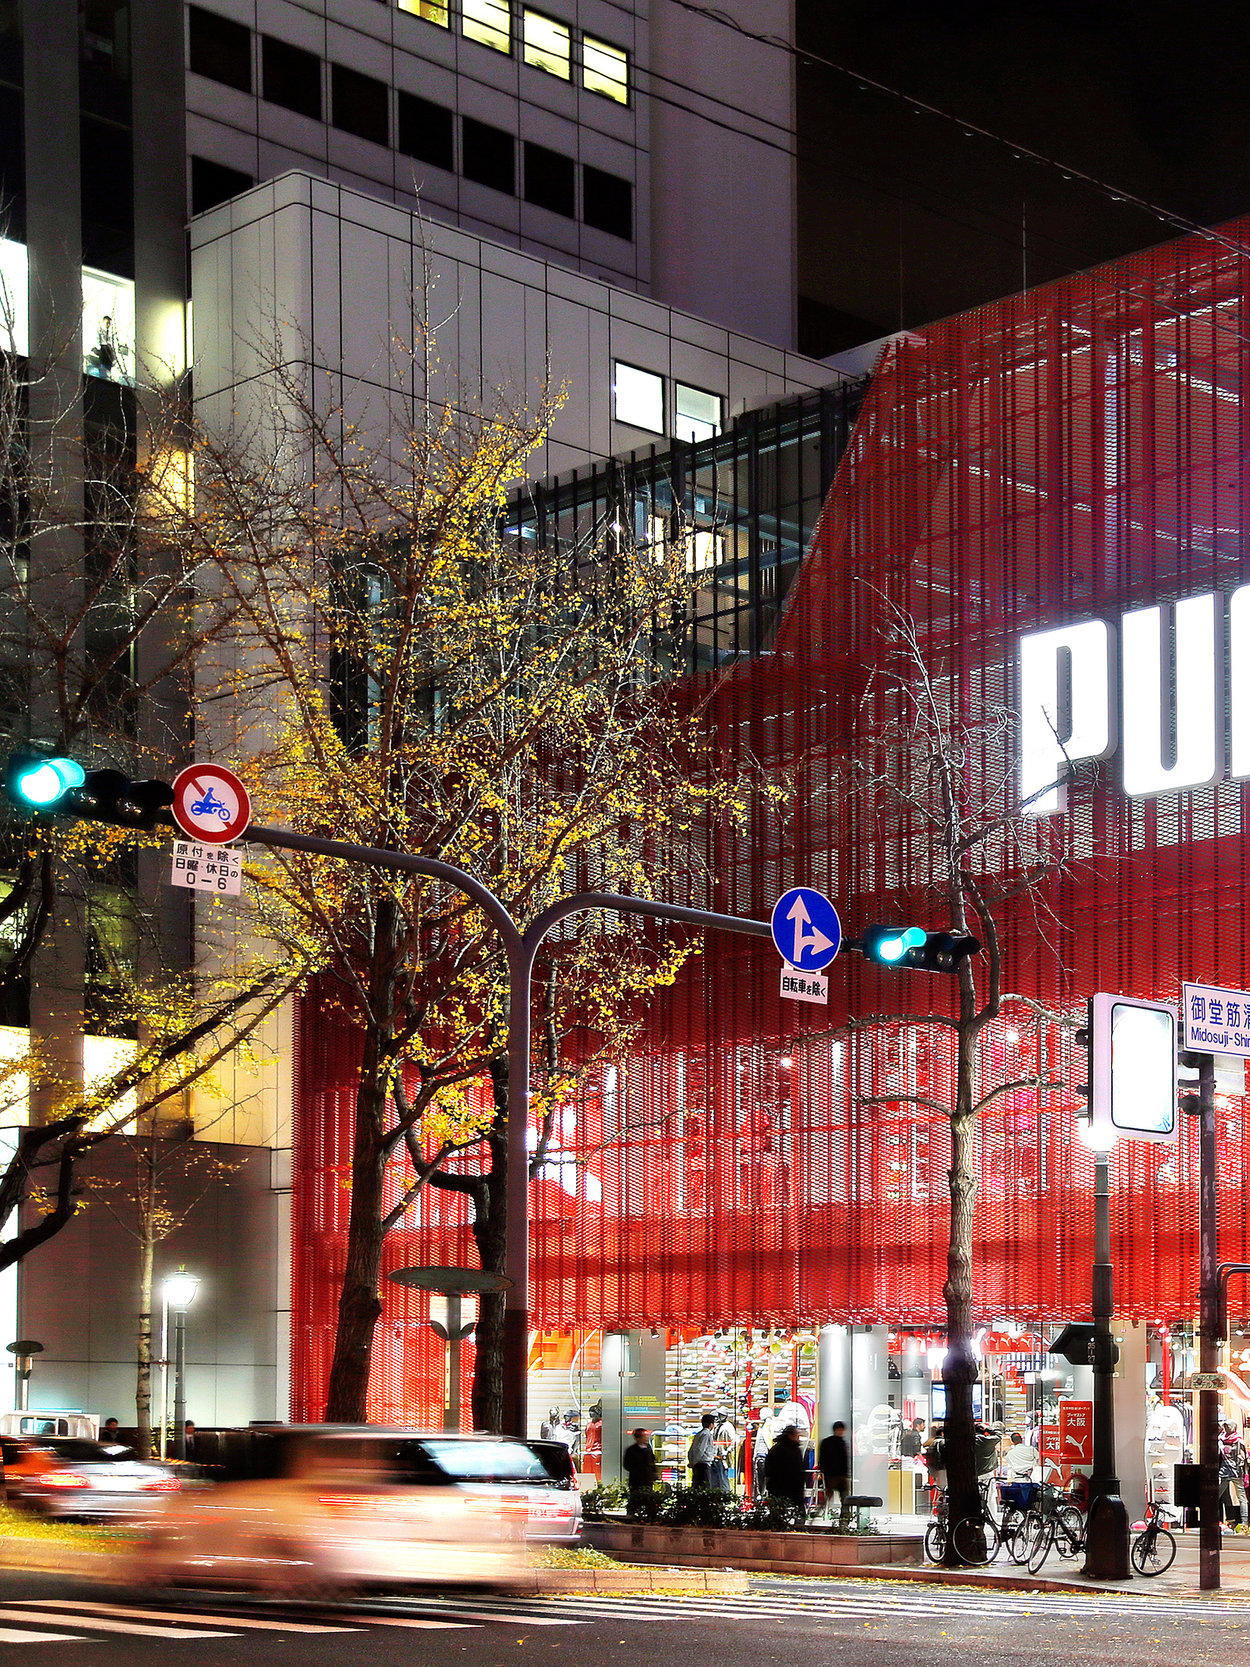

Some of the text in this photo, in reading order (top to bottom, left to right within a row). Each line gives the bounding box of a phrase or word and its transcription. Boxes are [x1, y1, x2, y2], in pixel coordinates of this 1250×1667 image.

[177, 843, 239, 864] 原付を除く
[782, 976, 826, 997] 自転車を除く
[1066, 1418, 1086, 1427] 大阪
